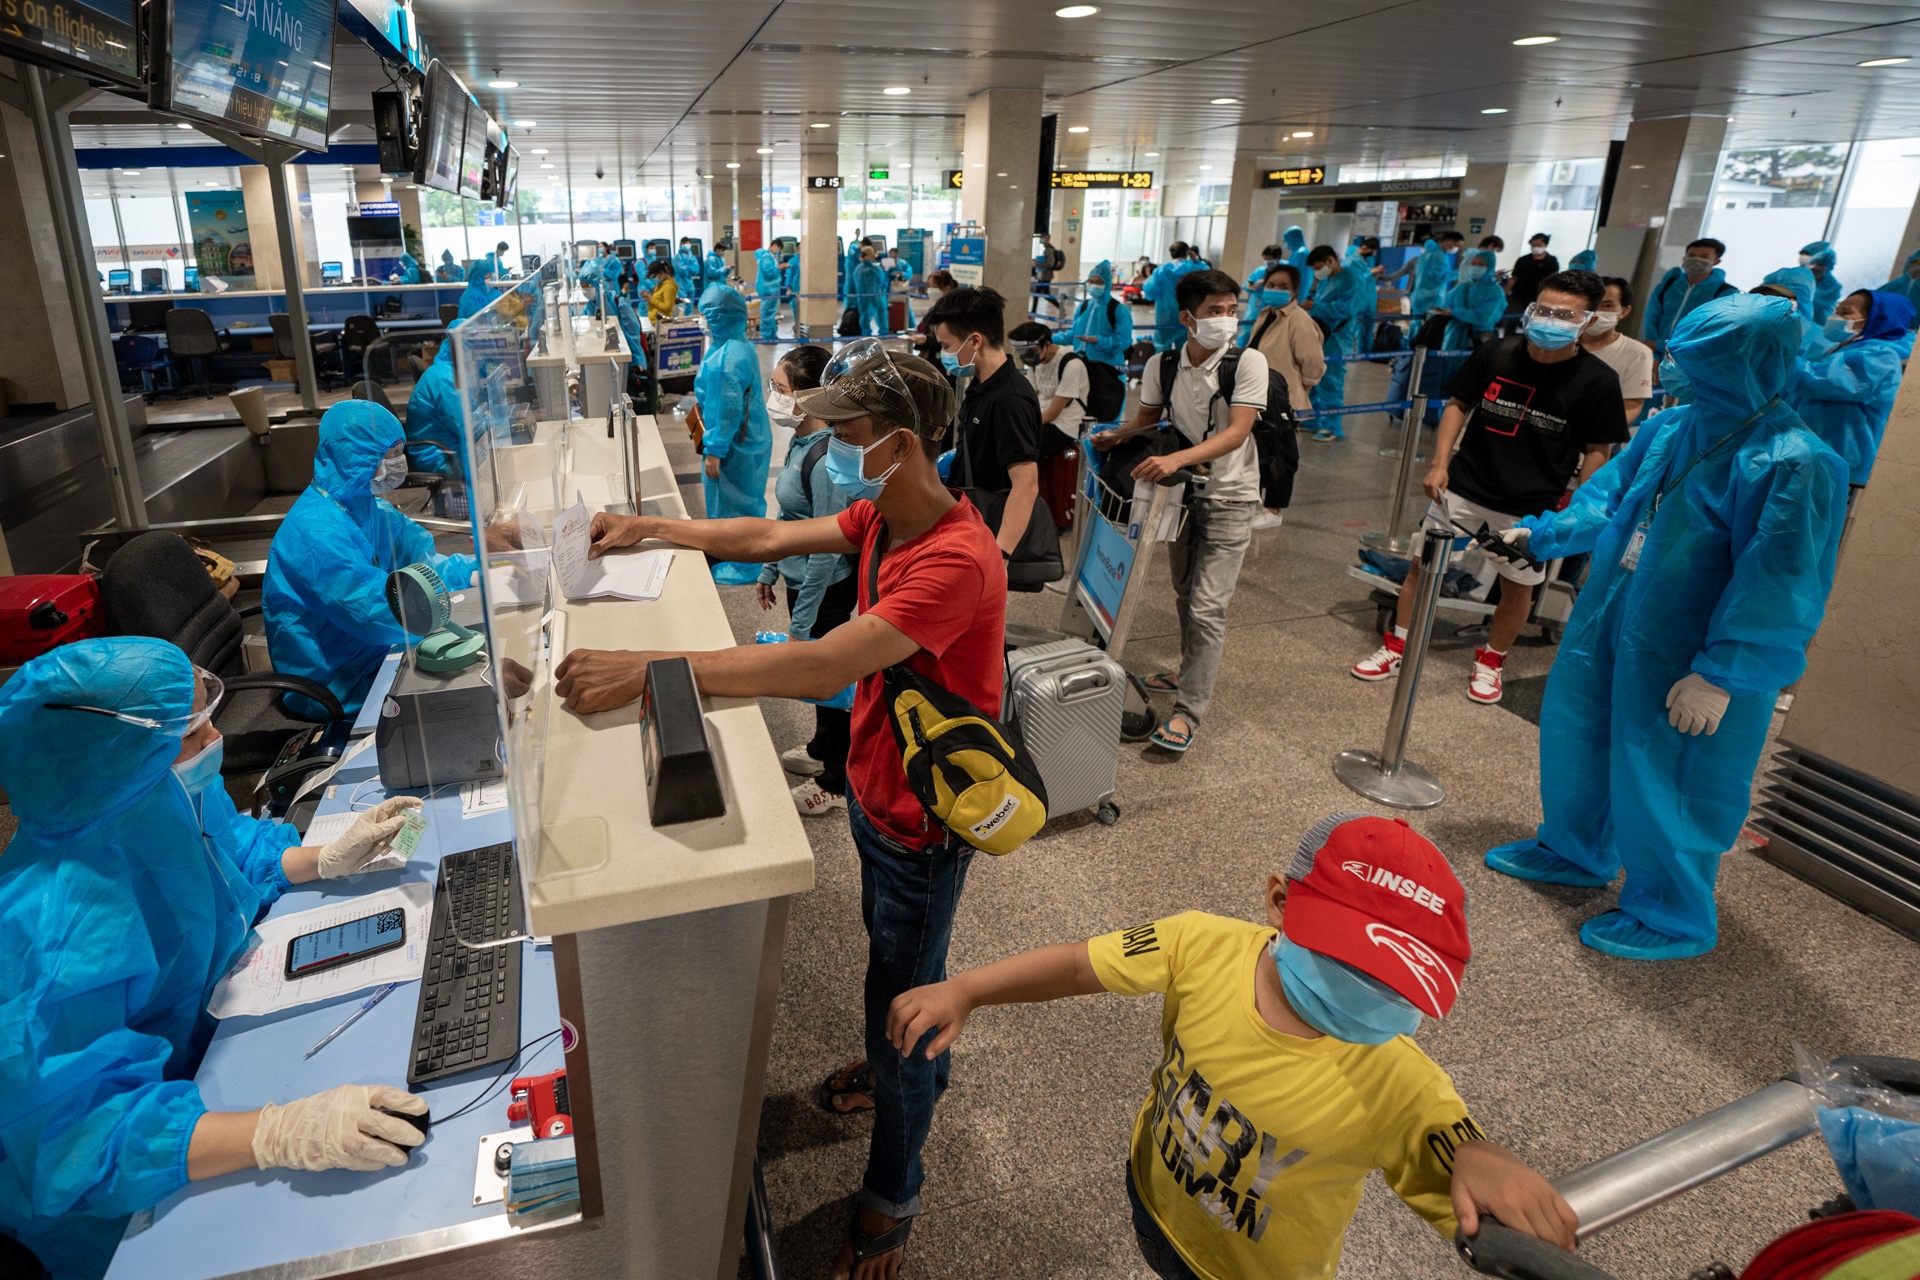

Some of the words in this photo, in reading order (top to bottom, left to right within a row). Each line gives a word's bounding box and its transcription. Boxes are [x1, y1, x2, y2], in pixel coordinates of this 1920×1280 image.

[23, 1, 48, 29] on
[53, 4, 105, 51] flights
[815, 177, 840, 187] 8:15
[1121, 173, 1151, 188] 1-23
[1381, 182, 1410, 192] SASCO
[1411, 180, 1452, 190] PREMIUM
[1496, 398, 1517, 408] NEVER
[1531, 409, 1567, 424] EXPLORING
[983, 798, 1011, 830] weber
[1371, 867, 1446, 915] INSEE
[1157, 1034, 1310, 1200] GARY
